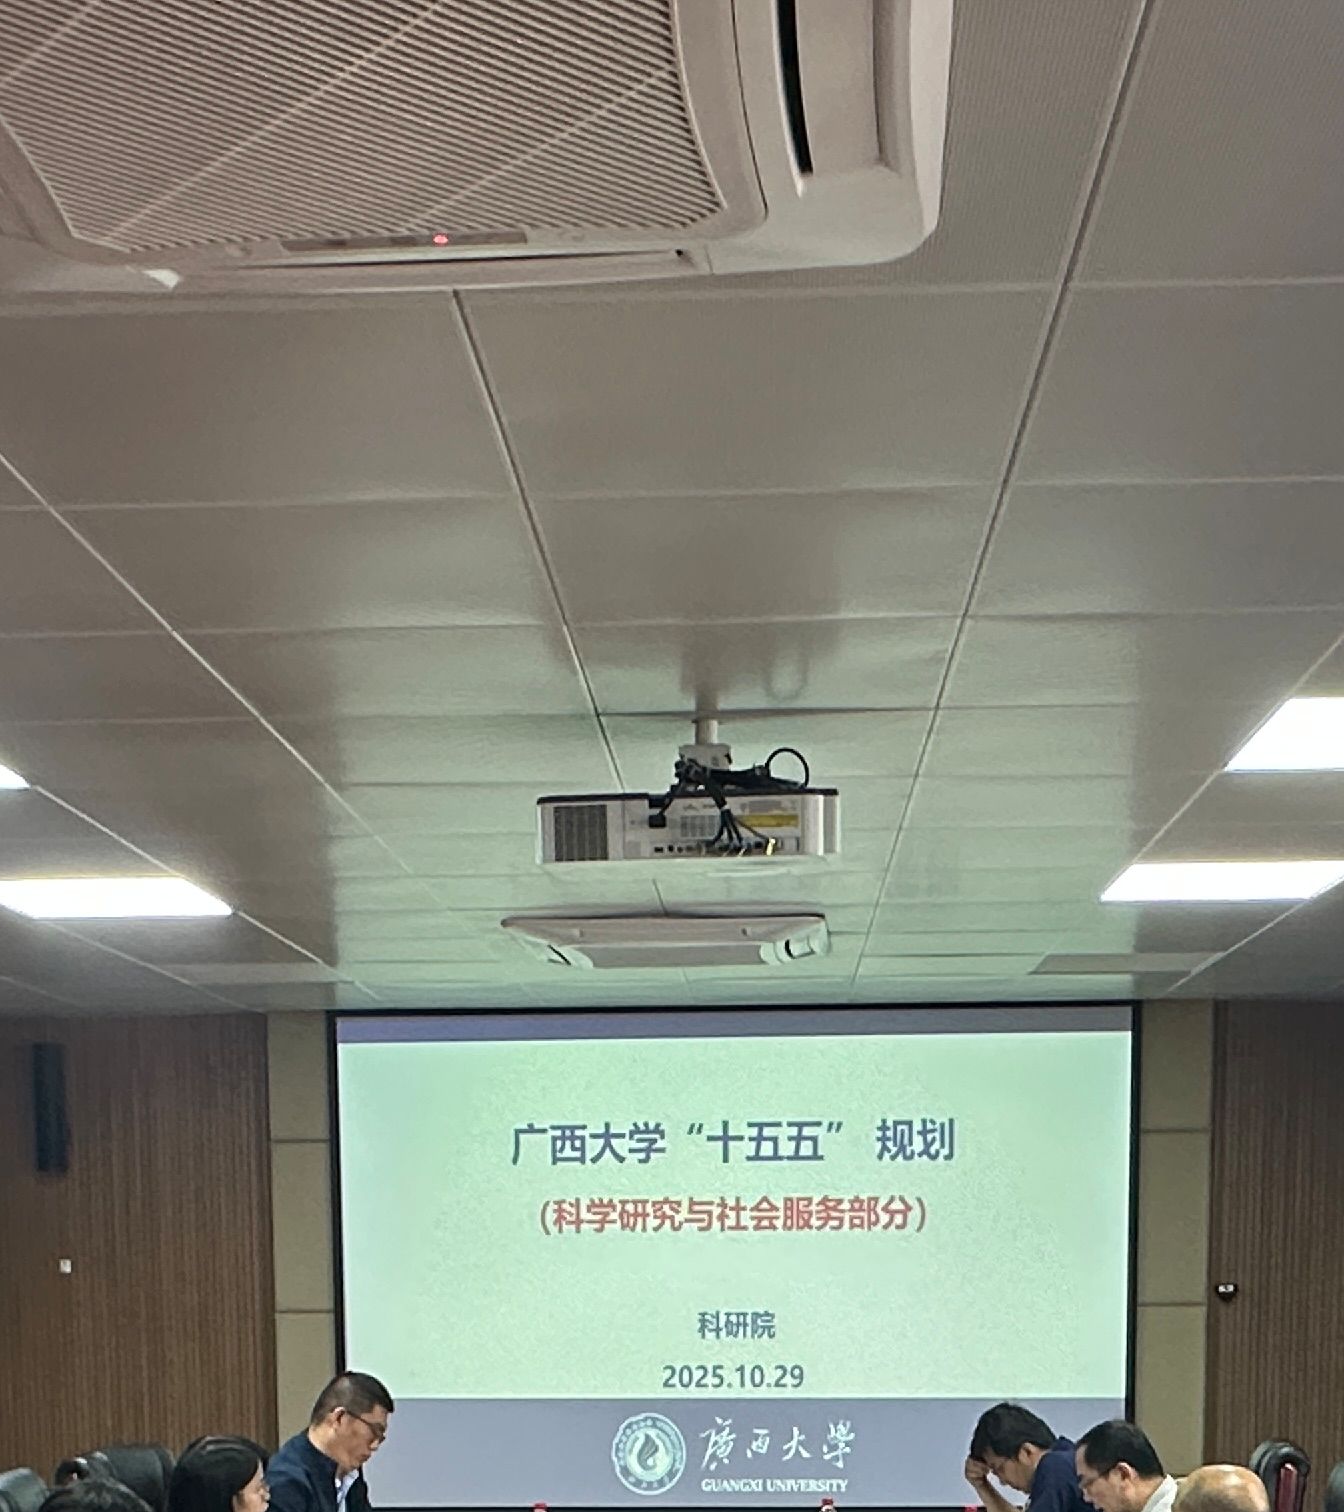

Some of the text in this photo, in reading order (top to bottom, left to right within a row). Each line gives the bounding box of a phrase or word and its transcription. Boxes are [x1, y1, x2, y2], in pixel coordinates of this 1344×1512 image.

[697, 1311, 776, 1339] 科研院
[662, 1364, 804, 1389] 2025.10.29
[701, 1478, 849, 1492] GUANGXI UNIVERSITY
